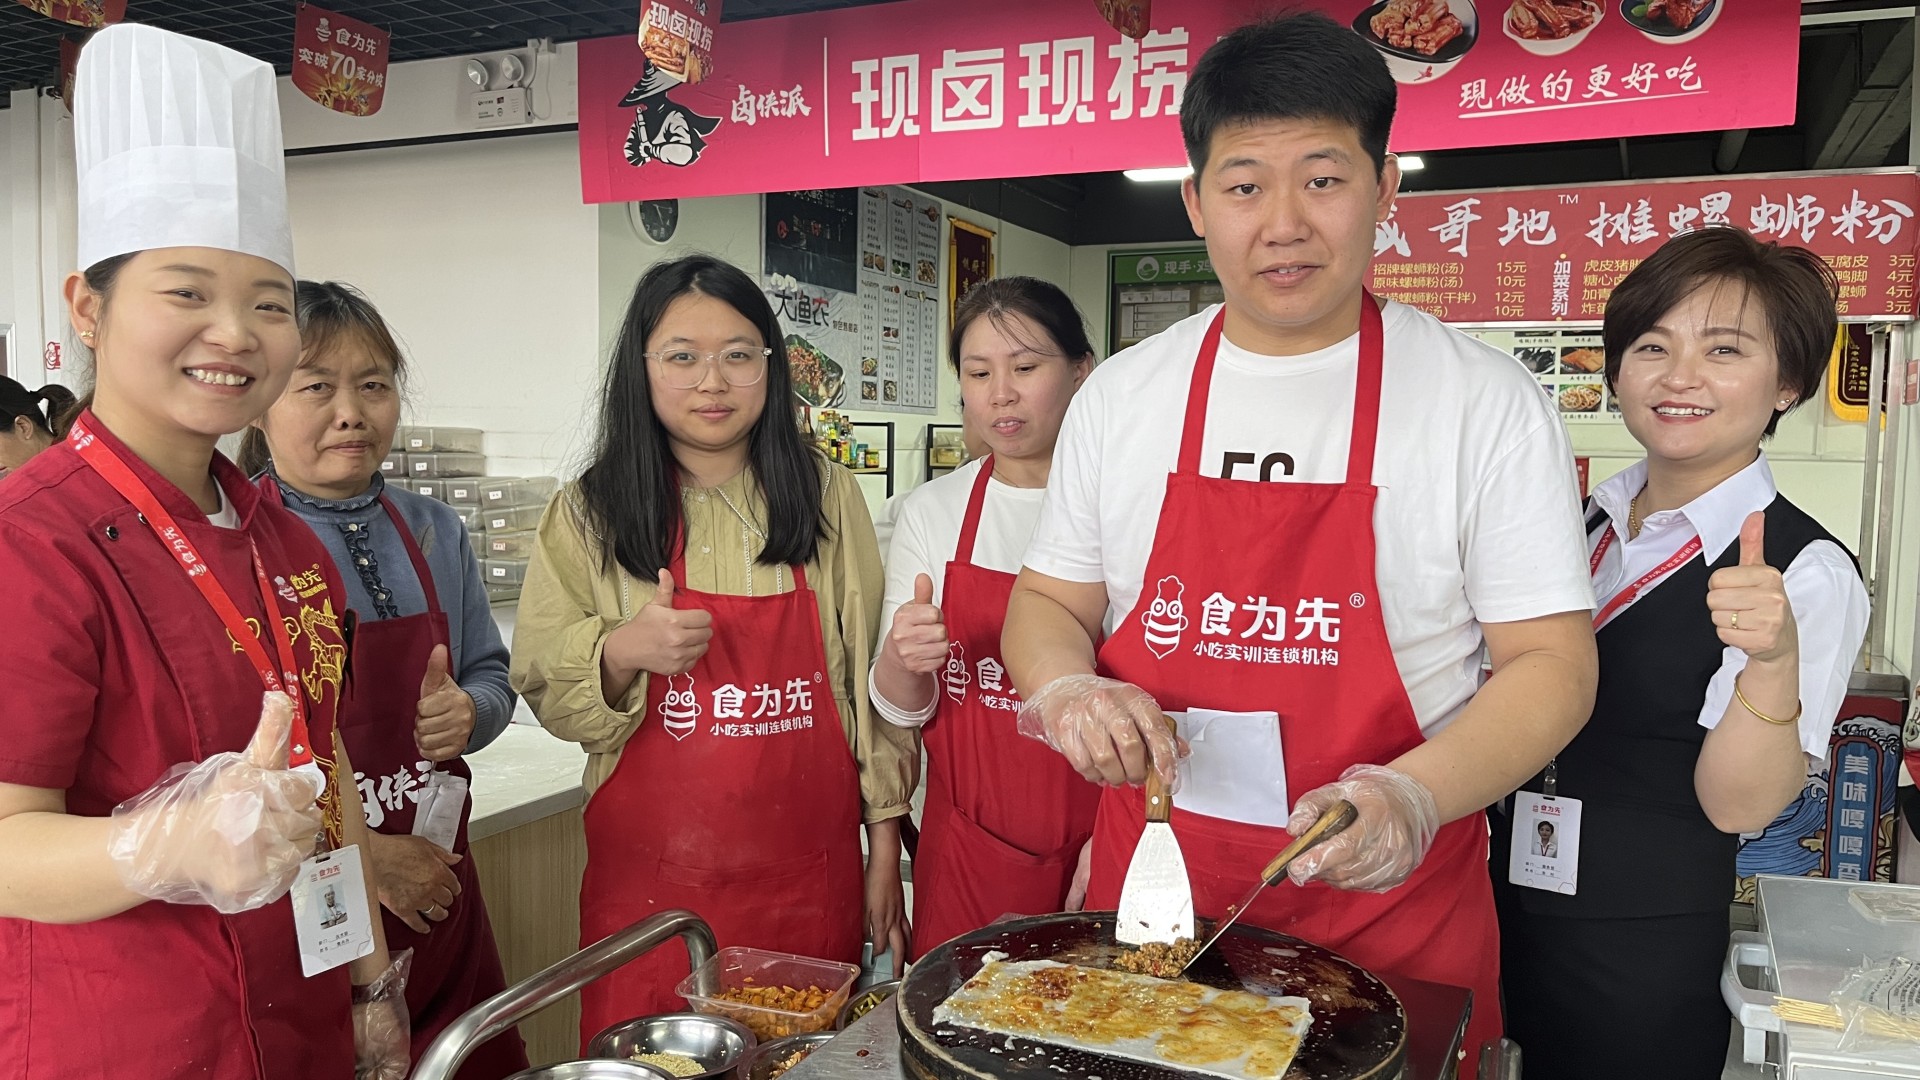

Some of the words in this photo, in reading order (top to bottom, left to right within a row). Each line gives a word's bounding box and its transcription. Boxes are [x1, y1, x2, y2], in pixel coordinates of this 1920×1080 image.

[649, 1, 713, 52] 现卤现捞
[336, 28, 377, 56] 食为先
[298, 48, 384, 88] 突破70家分校
[852, 27, 1189, 141] 现卤现捞
[731, 84, 811, 126] 卤侠派
[1558, 194, 1578, 204] TM
[1373, 262, 1464, 275] 招牌螺蛳粉(汤)
[1497, 262, 1527, 273] 15元
[1888, 255, 1915, 267] 3元
[1372, 276, 1463, 288] 原味螺蛳粉(汤)
[1496, 276, 1526, 287] 10元
[1551, 260, 1571, 316] 加菜系列
[1887, 270, 1913, 283] 4元
[1495, 291, 1525, 303] 12元
[1886, 286, 1912, 298] 4元
[1494, 305, 1524, 317] 10元
[1885, 301, 1911, 313] 3元
[1201, 592, 1341, 643] 食为先
[1193, 640, 1339, 666] 小吃实训连锁机构
[711, 677, 813, 719] 食为先
[709, 714, 813, 737] 小吃实训连锁机构
